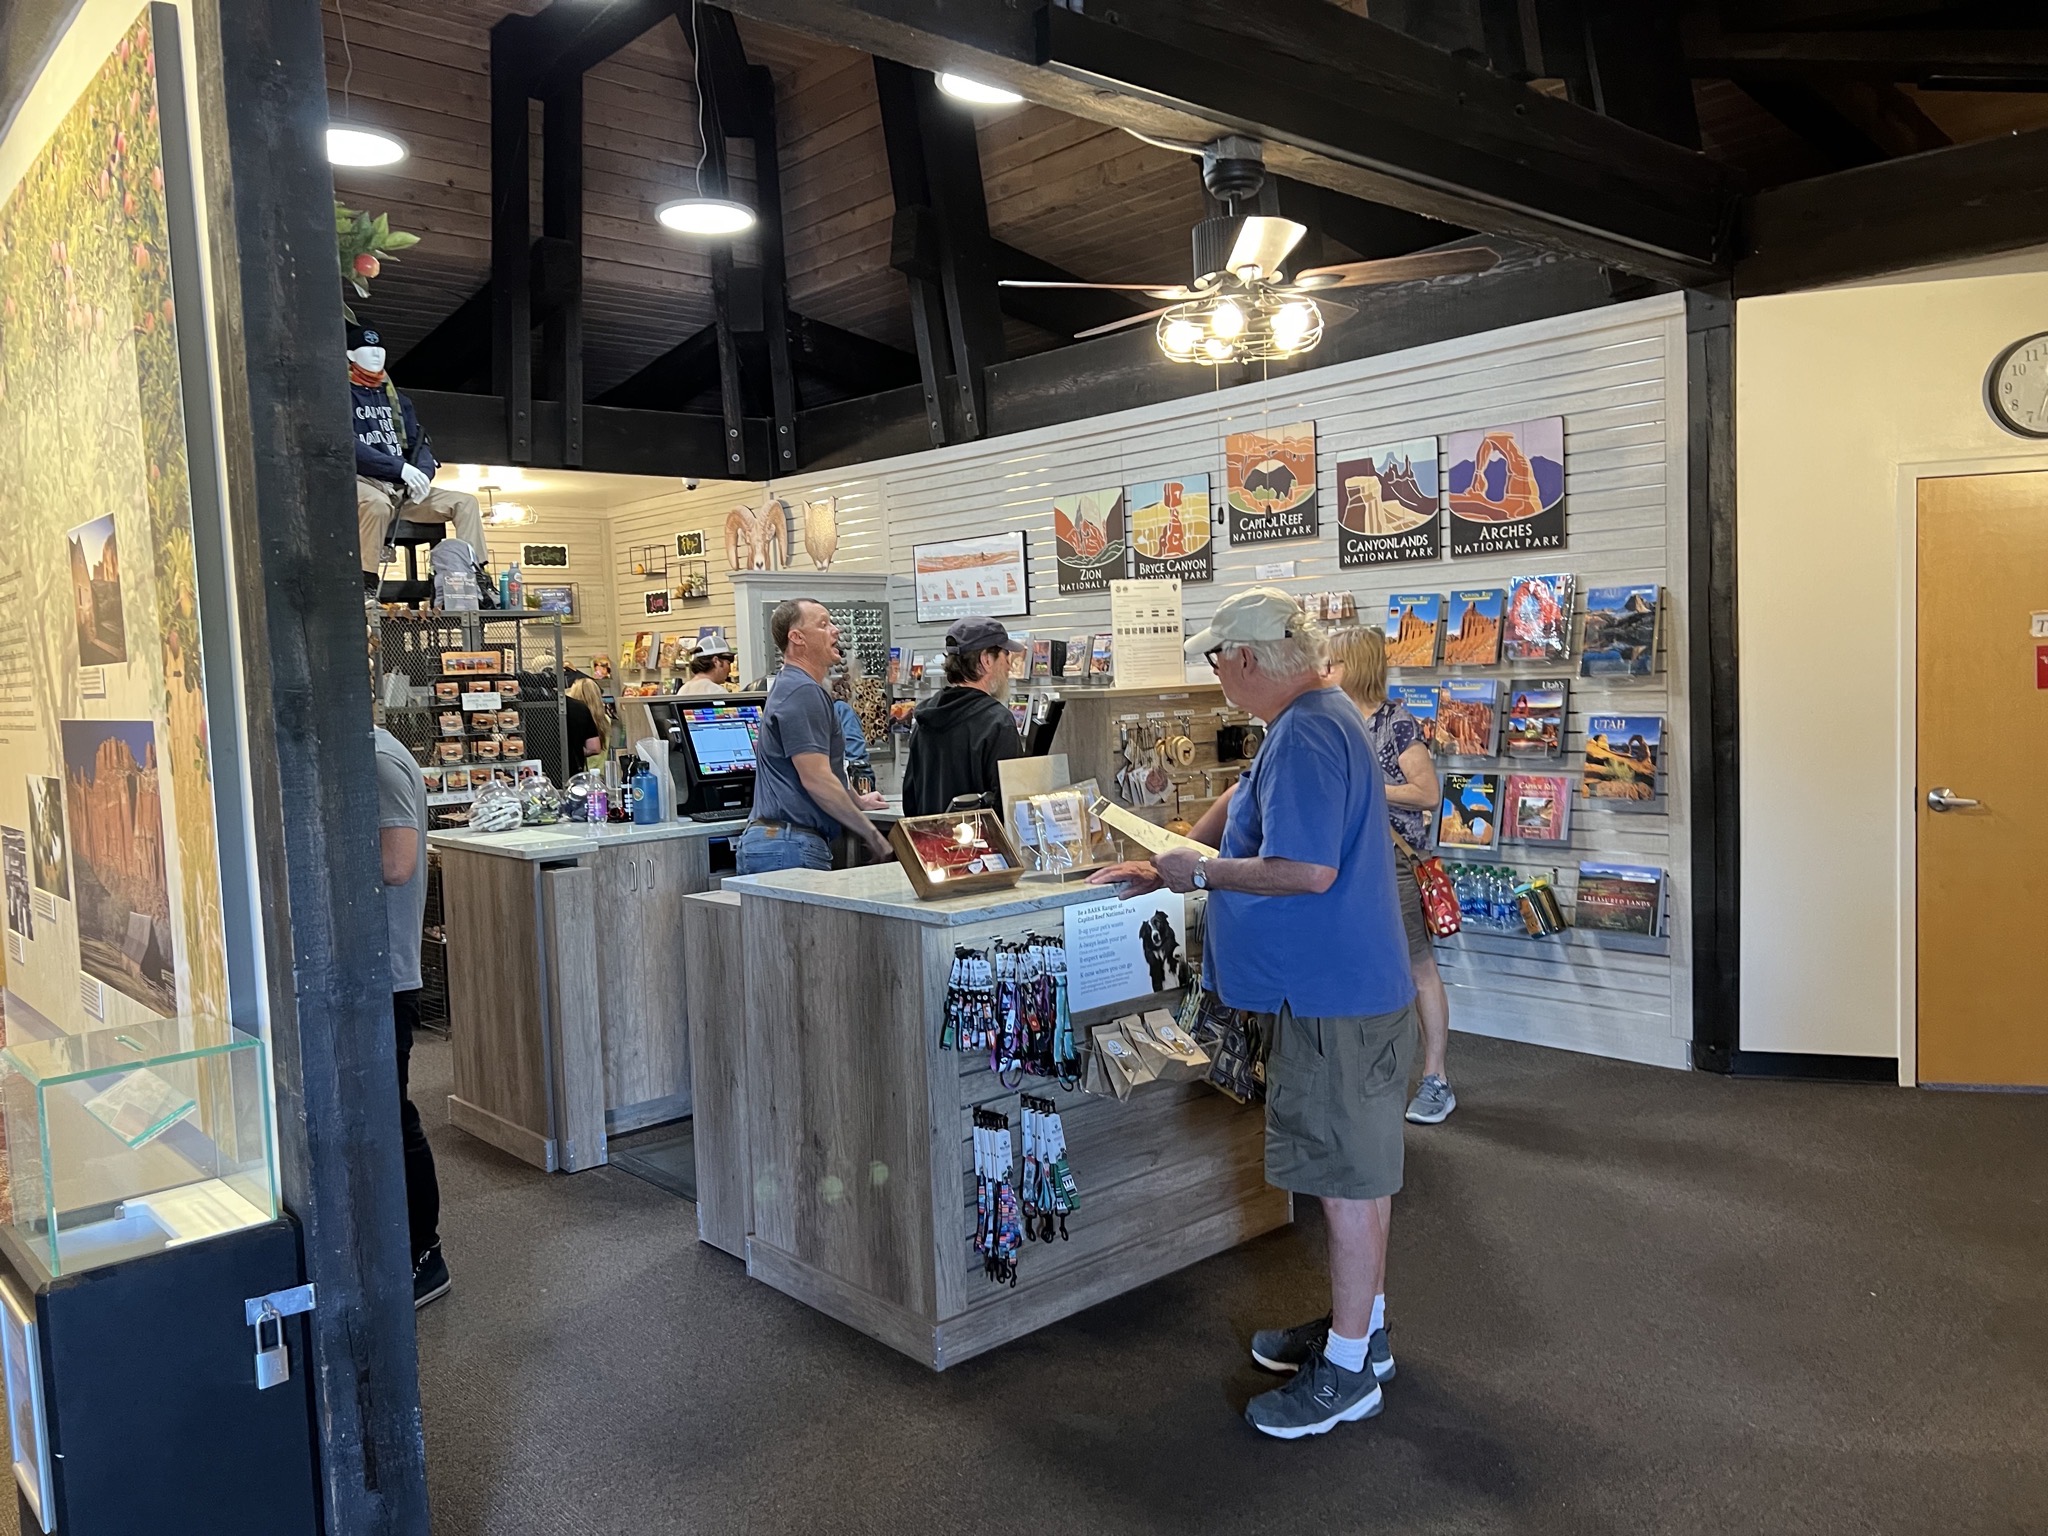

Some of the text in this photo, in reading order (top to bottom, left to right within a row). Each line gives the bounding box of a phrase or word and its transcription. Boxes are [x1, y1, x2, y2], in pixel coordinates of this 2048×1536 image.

[2025, 349, 2039, 361] 11
[2012, 363, 2026, 376] 10
[2004, 382, 2013, 394] 9
[2011, 398, 2019, 411] 8
[2026, 410, 2034, 423] 7
[1240, 512, 1303, 531] CAPITOL REEF
[1232, 525, 1311, 542] NATIONAL PARK
[1479, 523, 1533, 541] ARCHES
[1346, 534, 1428, 553] CANYONLANDS
[1454, 536, 1559, 554] NATIONAL PARK
[1344, 547, 1434, 564] NATIONAL PARK
[1139, 557, 1207, 575] BRYCE CANYON
[1080, 569, 1102, 580] ZION
[1185, 570, 1208, 580] PARK
[1060, 581, 1100, 592] NATIONAL
[1594, 719, 1625, 730] UTAH
[1583, 895, 1651, 907] TREASURED LANDS
